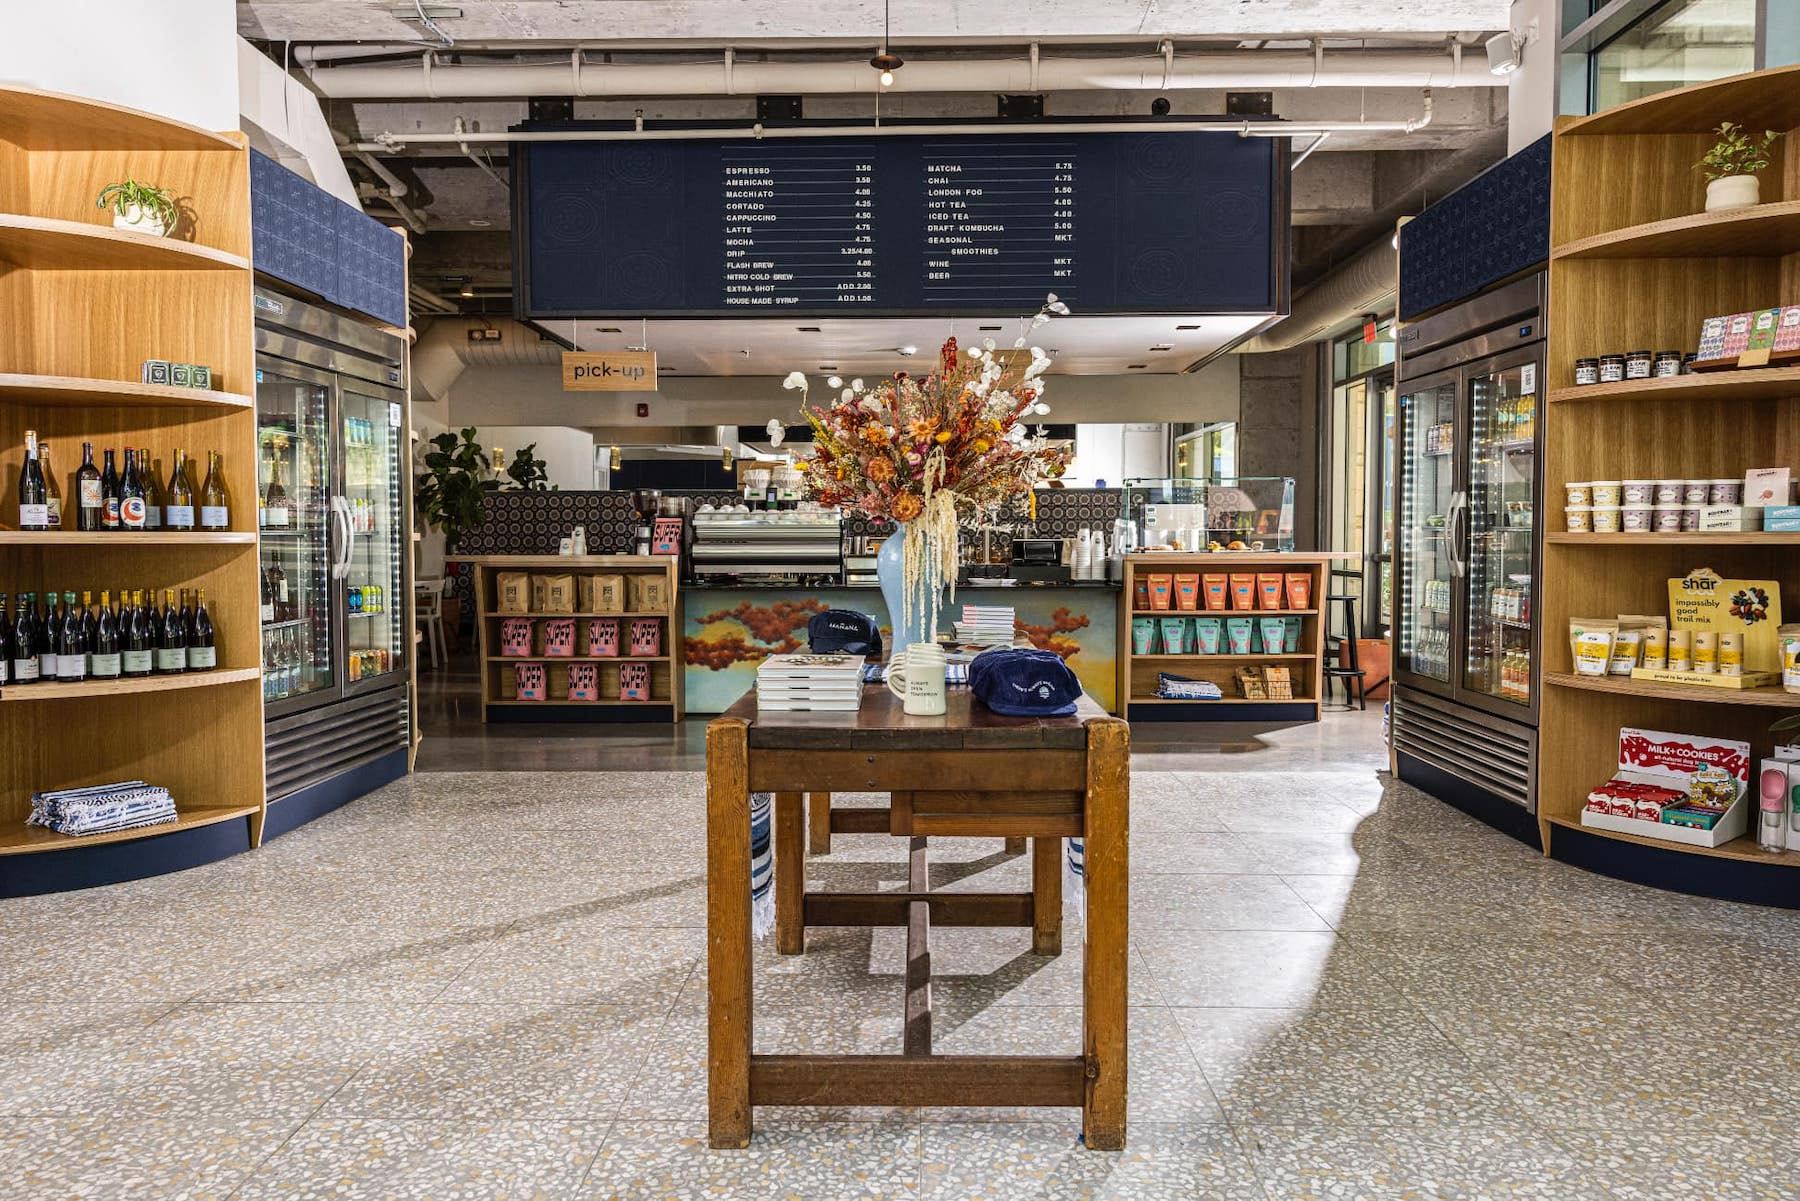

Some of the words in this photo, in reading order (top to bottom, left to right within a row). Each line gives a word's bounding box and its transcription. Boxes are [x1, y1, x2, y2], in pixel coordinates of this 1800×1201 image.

[574, 361, 645, 381] pick-up
[654, 524, 680, 543] SUPER
[1676, 599, 1720, 608] impossibly
[503, 622, 527, 646] SUPER
[546, 622, 571, 646] SUPER
[590, 622, 615, 645] SUPER
[632, 622, 657, 645] SUPER
[516, 665, 542, 689] SUPER
[569, 665, 594, 689] SUPER
[621, 665, 646, 689] SUPER
[1676, 748, 1719, 760] COOKIES
